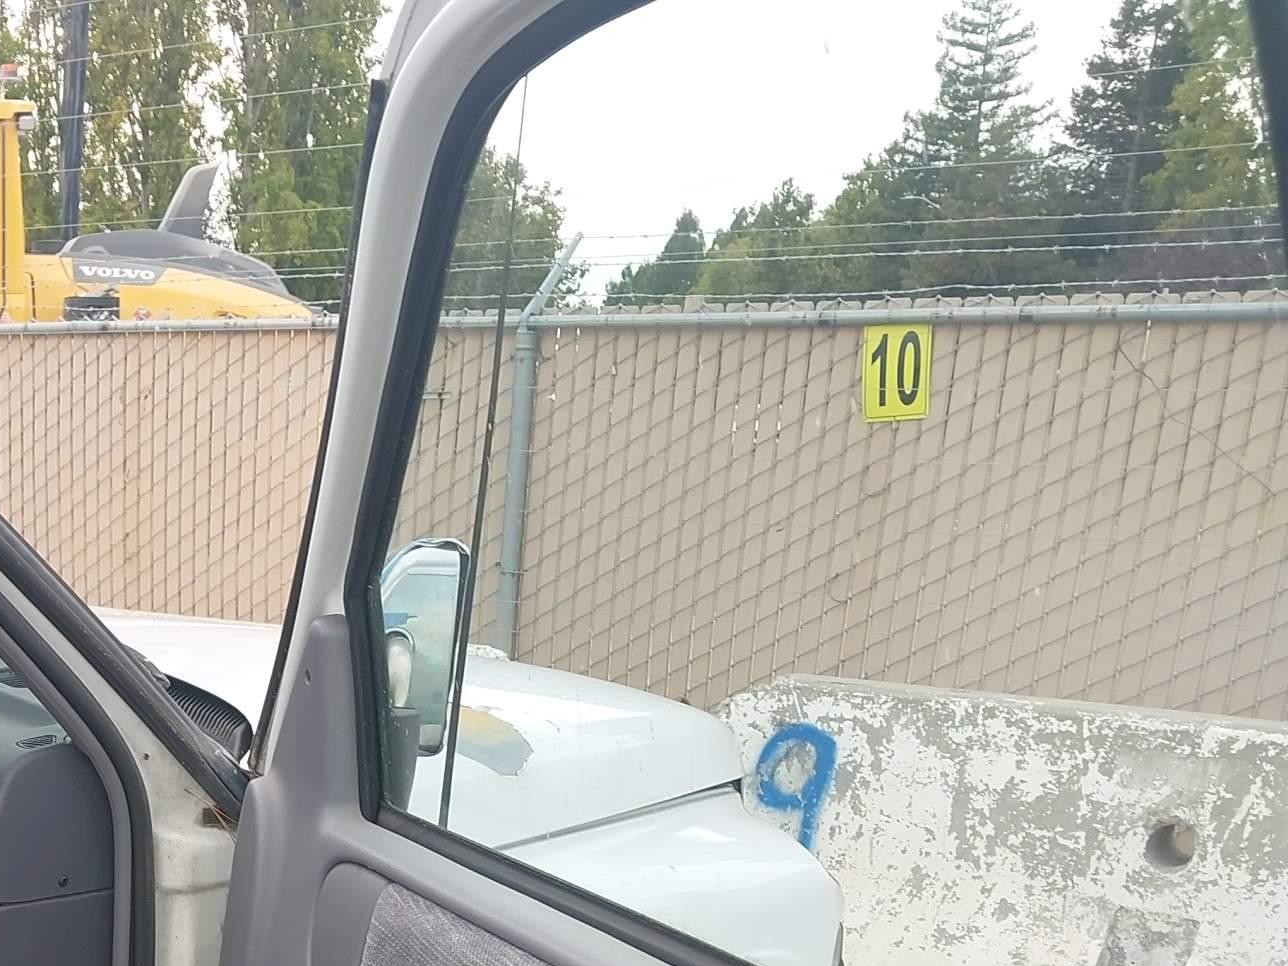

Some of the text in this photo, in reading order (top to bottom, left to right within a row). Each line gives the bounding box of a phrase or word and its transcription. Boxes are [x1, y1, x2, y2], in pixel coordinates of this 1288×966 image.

[78, 266, 155, 279] VOLVO
[871, 331, 921, 407] 10
[757, 724, 836, 850] 9
